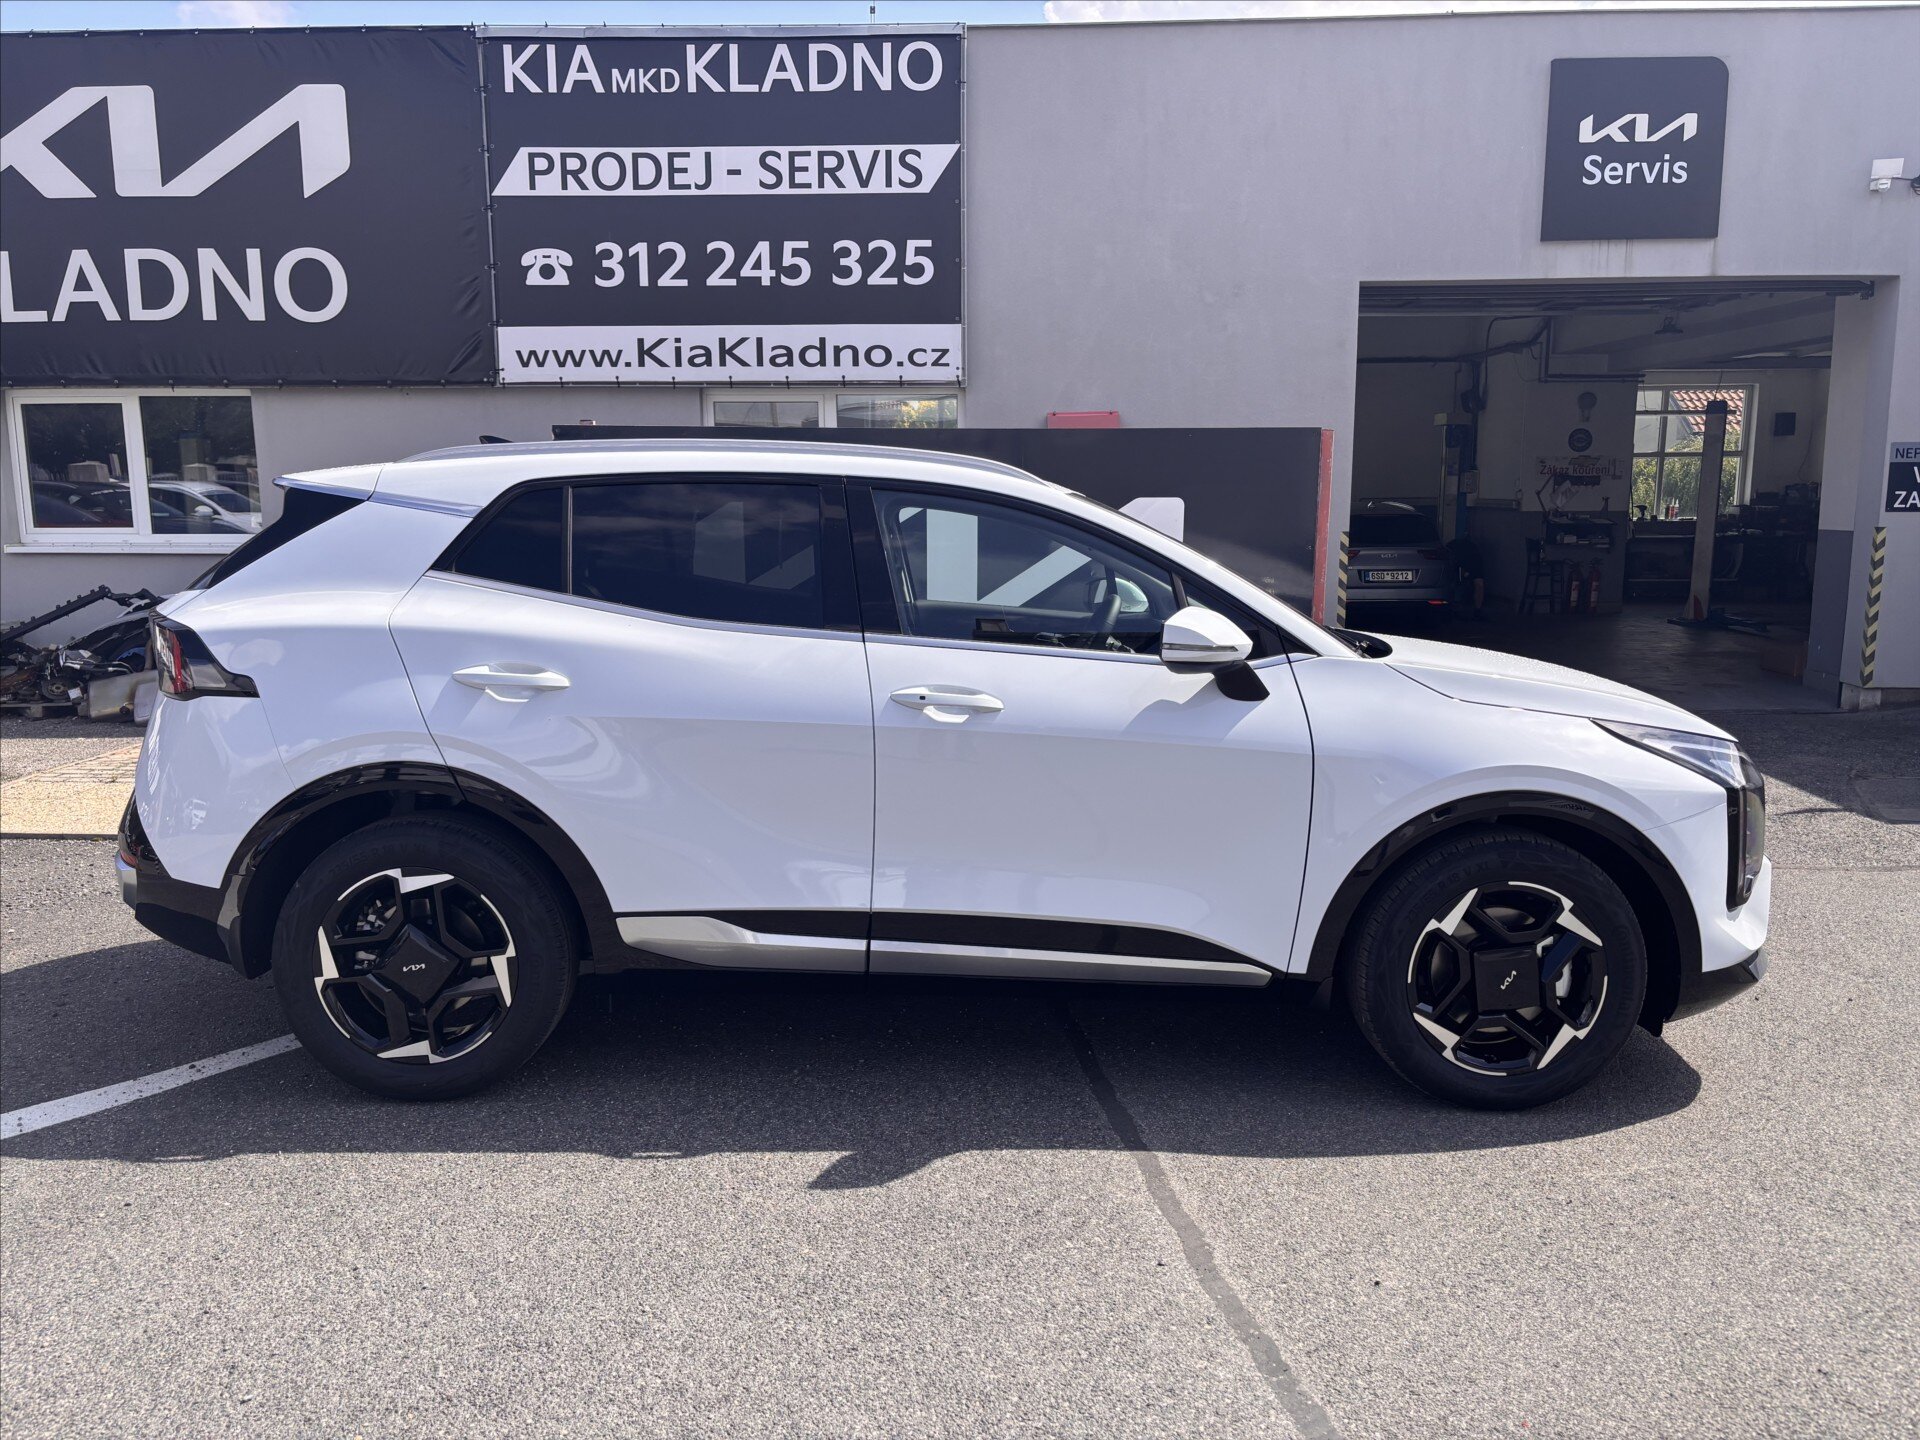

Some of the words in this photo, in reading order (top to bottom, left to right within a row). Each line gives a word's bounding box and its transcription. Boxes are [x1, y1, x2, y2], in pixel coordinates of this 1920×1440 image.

[503, 43, 605, 94] KIA
[611, 68, 680, 94] MKD
[686, 41, 943, 93] KLADNO
[527, 152, 713, 191] PRODEJ
[758, 149, 923, 189] SERVIS
[1582, 154, 1688, 185] Servis
[594, 241, 688, 287] 312
[705, 241, 812, 286] 245
[831, 239, 935, 286] 325
[515, 336, 950, 369] www.KiaKladno.cz
